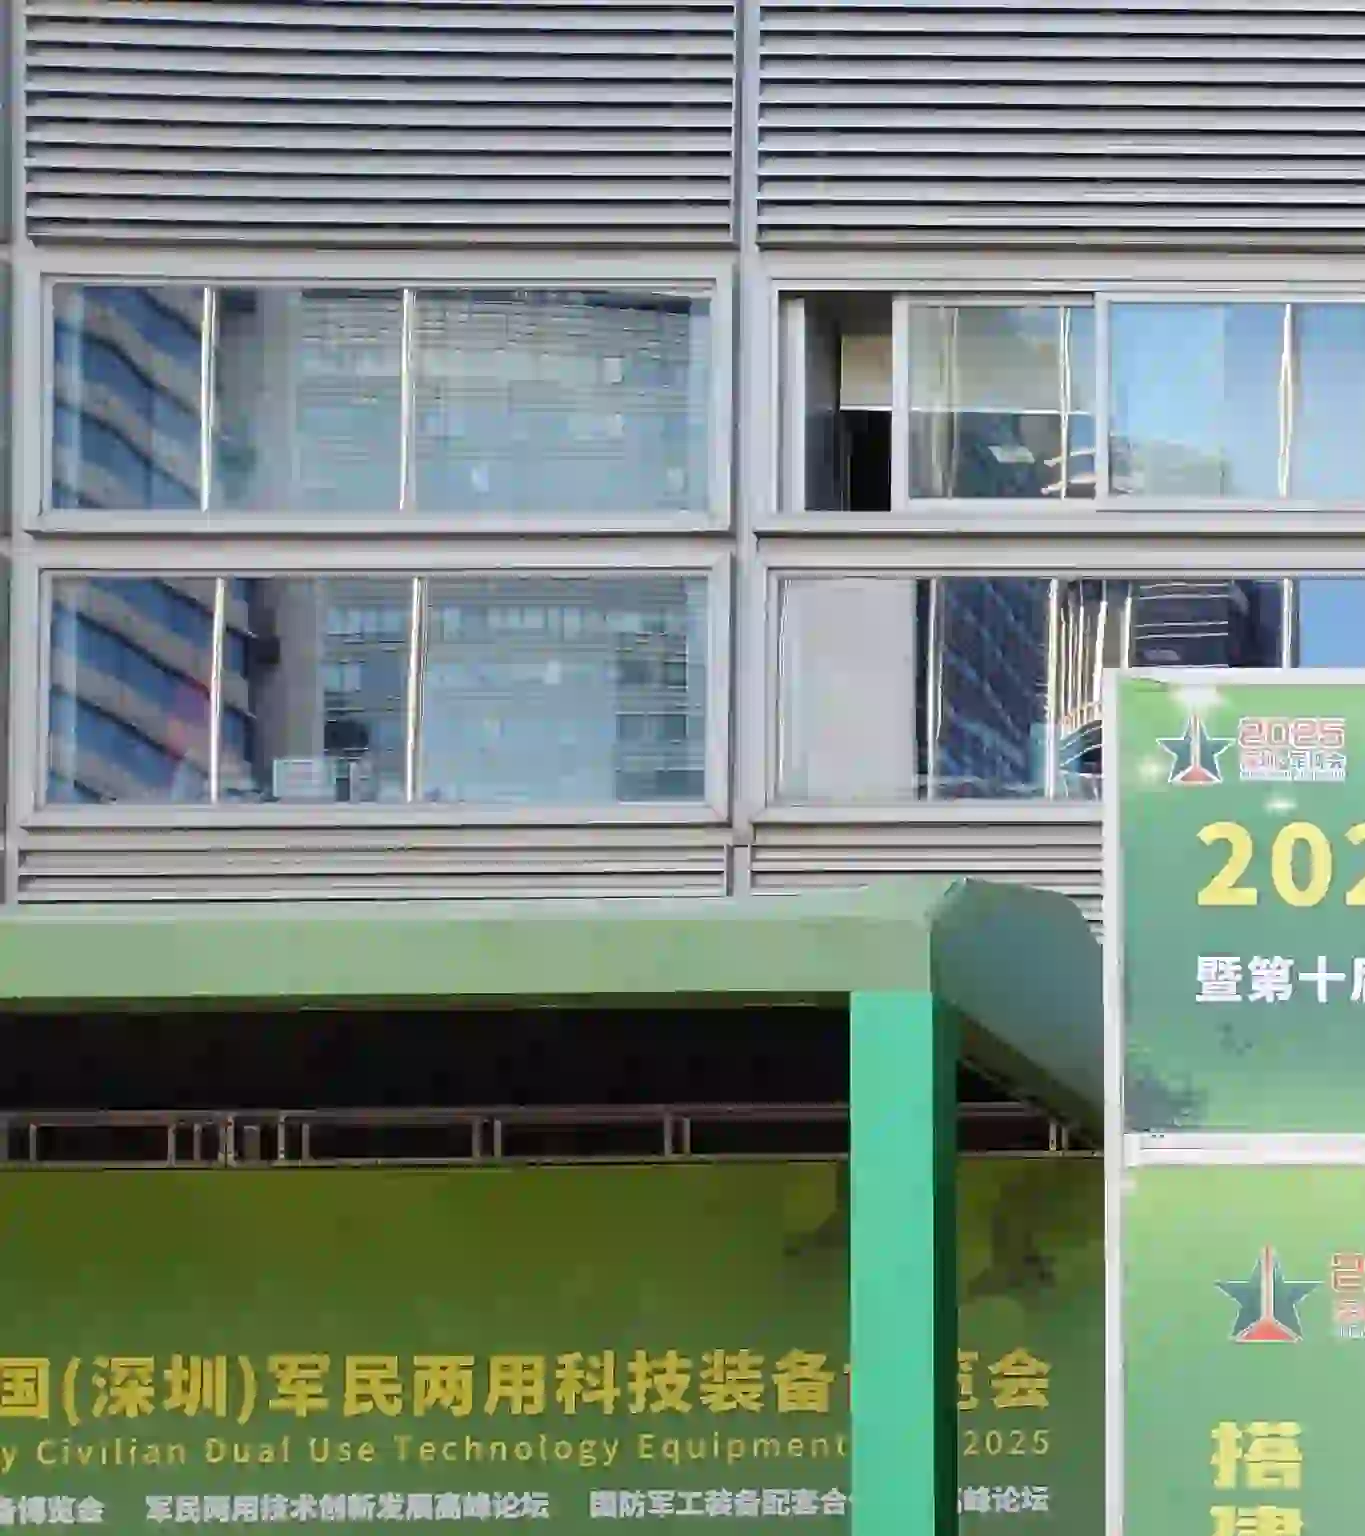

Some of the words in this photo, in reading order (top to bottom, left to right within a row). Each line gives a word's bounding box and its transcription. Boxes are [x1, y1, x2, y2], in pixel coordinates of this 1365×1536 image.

[1238, 716, 1346, 750] 2025
[0, 1348, 1051, 1425] 国(深圳)军民两用科技装备会
[37, 1438, 186, 1466] Civilian
[205, 1435, 290, 1463] Dual
[309, 1437, 375, 1463] Use
[393, 1434, 620, 1467] Technology
[637, 1431, 847, 1466] Equipment
[962, 1430, 1050, 1456] 2025
